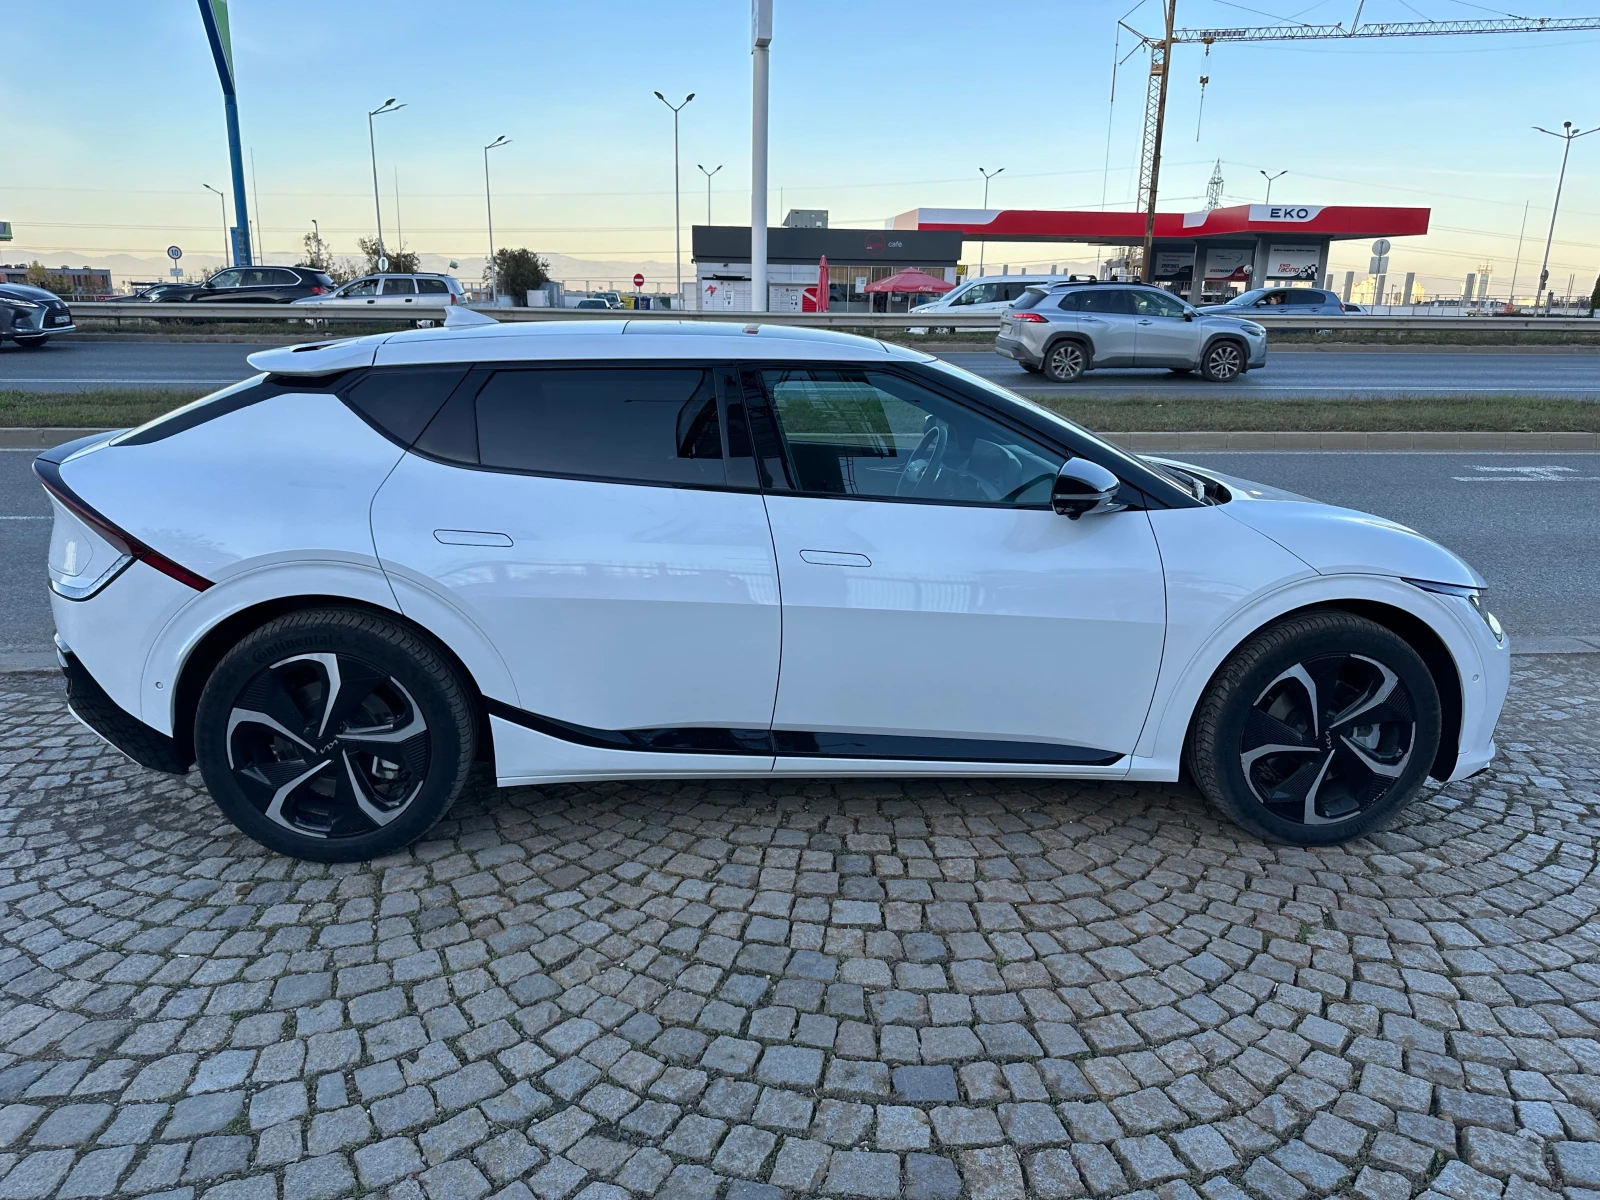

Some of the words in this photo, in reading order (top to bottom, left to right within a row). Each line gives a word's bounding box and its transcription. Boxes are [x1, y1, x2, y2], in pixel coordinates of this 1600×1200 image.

[1270, 208, 1309, 219] EKO
[888, 240, 903, 248] café
[171, 249, 179, 257] 10
[252, 633, 333, 664] Continental
